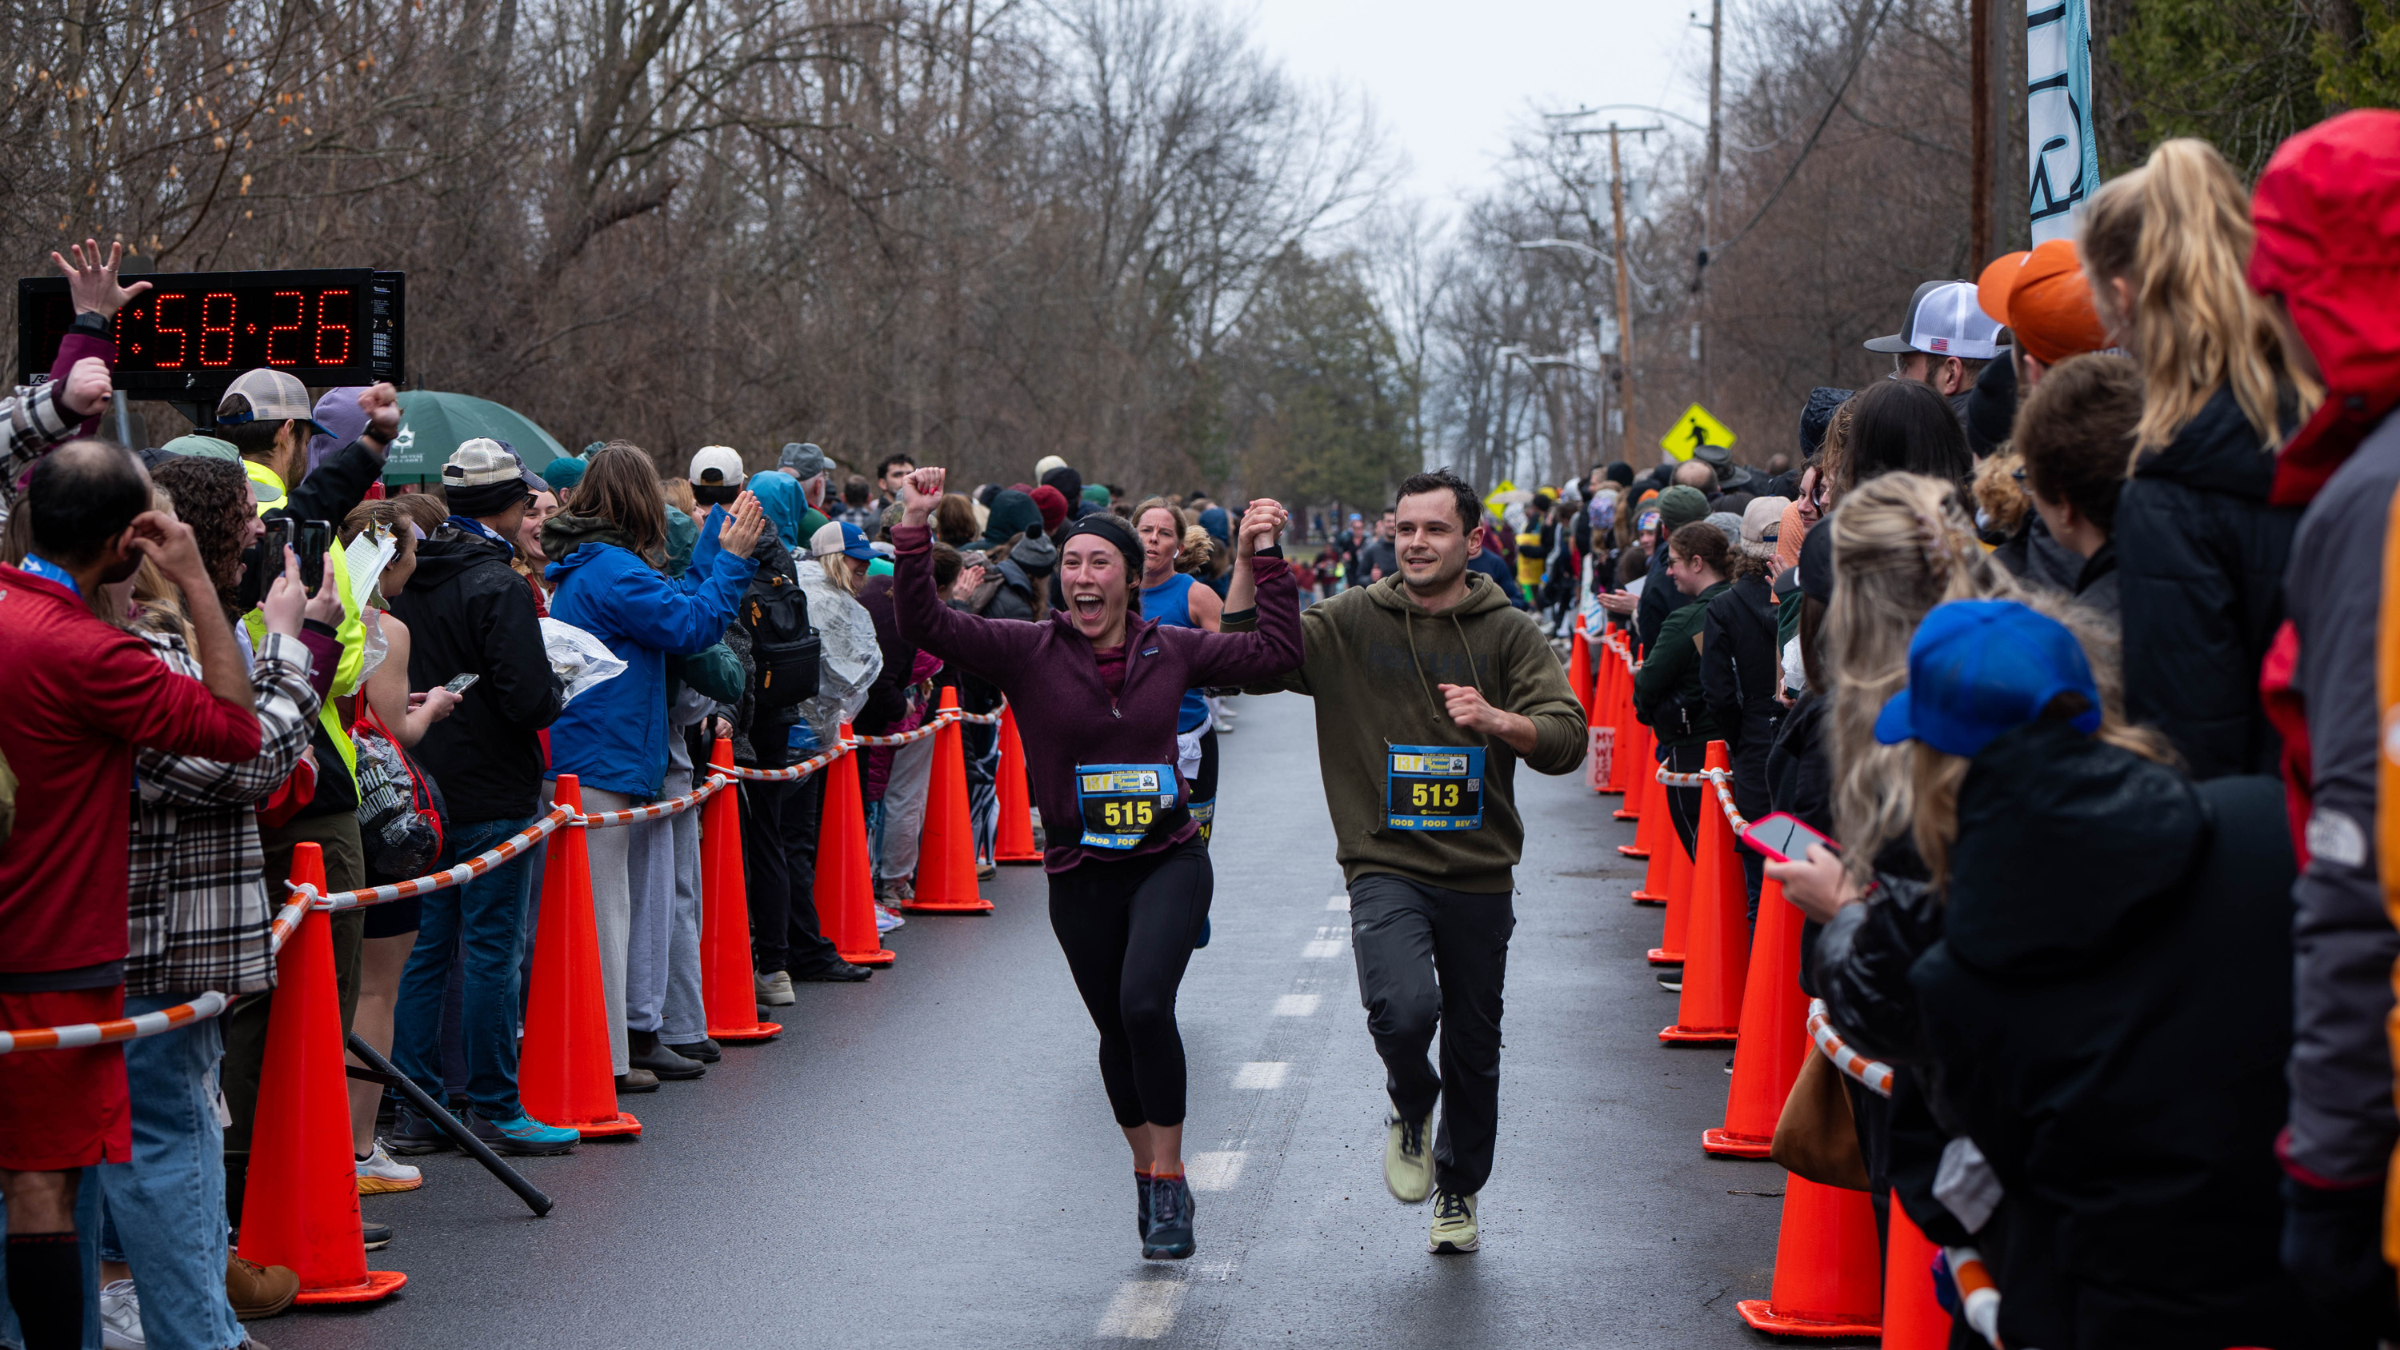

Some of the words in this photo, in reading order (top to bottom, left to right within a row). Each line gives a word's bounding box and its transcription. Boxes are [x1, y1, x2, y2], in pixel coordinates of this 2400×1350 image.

[1412, 784, 1459, 807] 513
[1105, 801, 1153, 826] 515
[1390, 819, 1414, 827] FOOD
[1422, 820, 1447, 828] FOOD
[1455, 820, 1471, 828] BEV
[1084, 835, 1110, 845] FOOD
